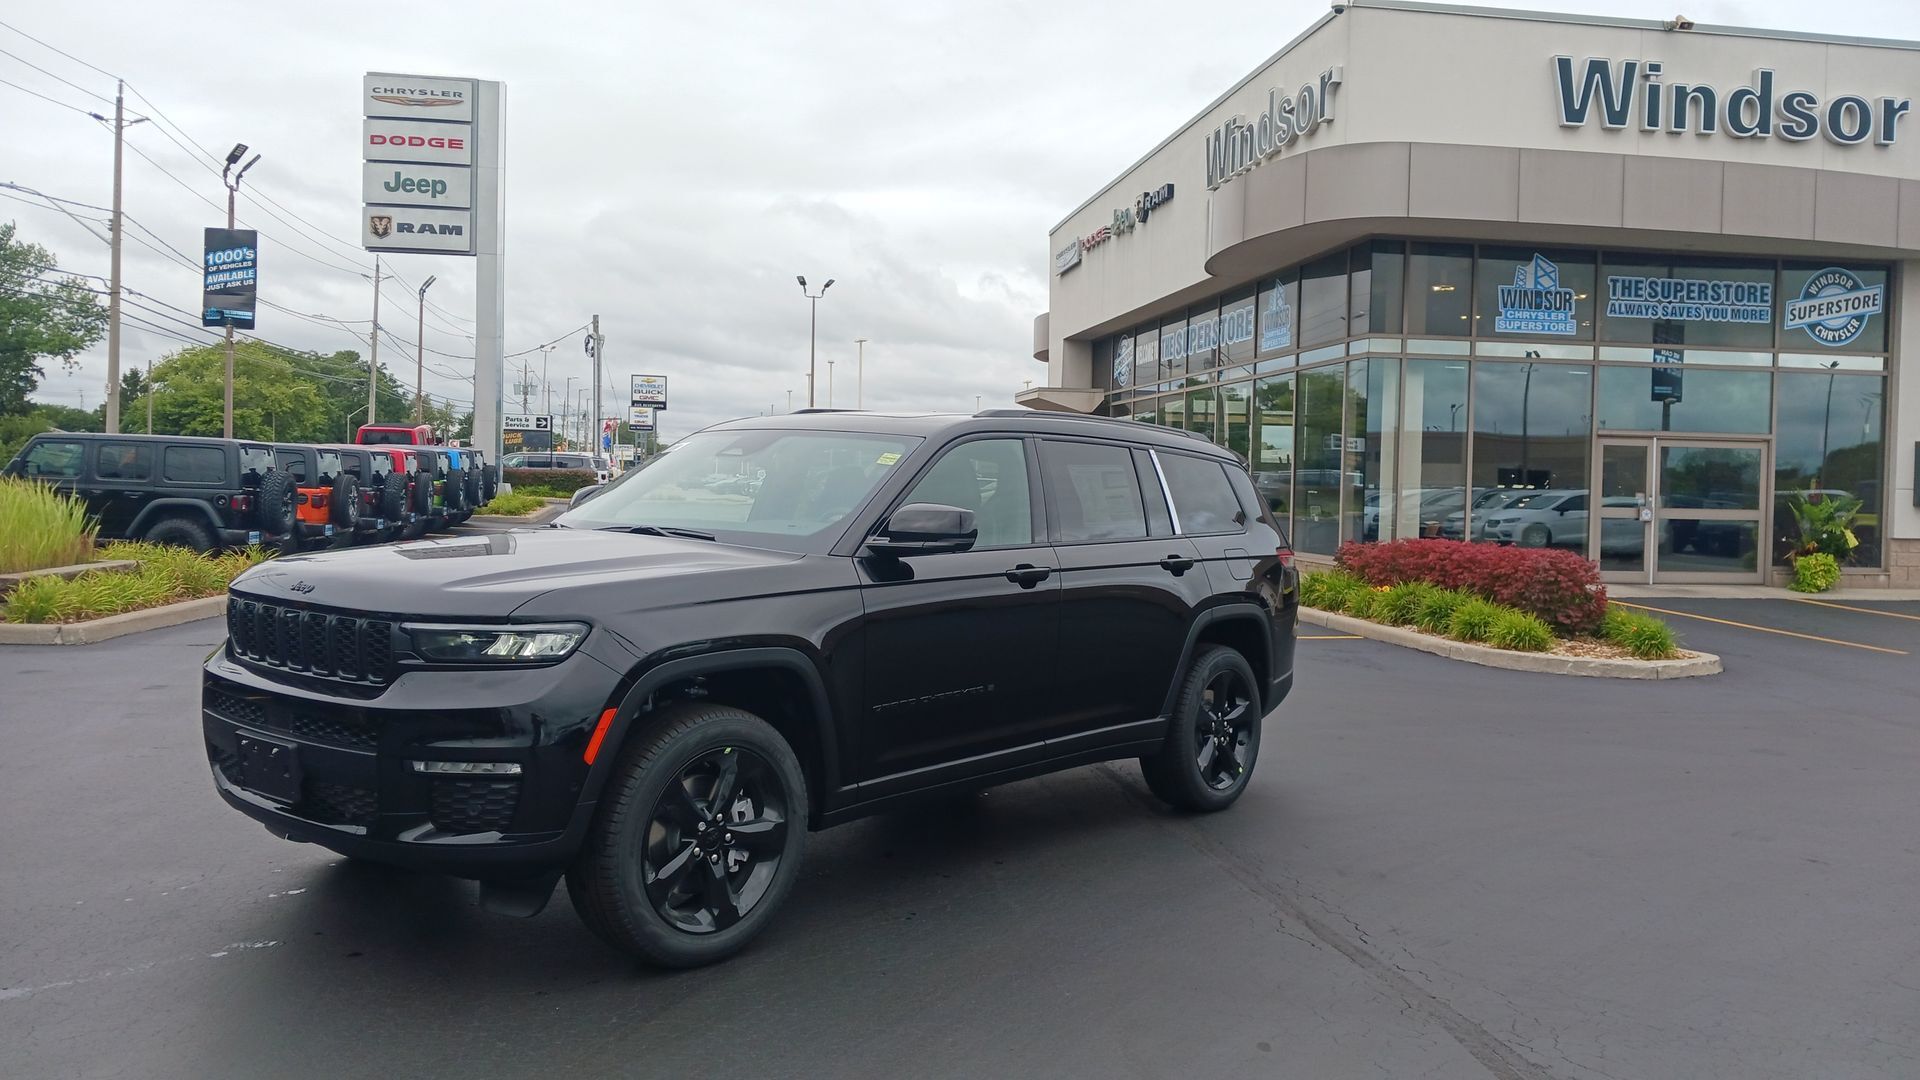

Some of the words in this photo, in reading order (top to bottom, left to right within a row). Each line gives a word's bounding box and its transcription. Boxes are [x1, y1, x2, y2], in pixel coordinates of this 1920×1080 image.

[372, 86, 463, 98] CHRYSLER
[1552, 53, 1912, 147] Windsor
[1205, 64, 1344, 191] Windsor
[369, 134, 464, 150] DODGE
[384, 171, 447, 198] Jeep
[1144, 184, 1174, 211] RAM
[396, 222, 463, 236] RAM
[207, 248, 255, 265] 1000's
[219, 260, 252, 270] VEHICLES
[207, 269, 255, 283] AVAILABLE
[1809, 273, 1854, 295] WINDSOR
[206, 282, 225, 291] JUST
[226, 280, 242, 288] ASK
[1609, 277, 1644, 298] THE
[1648, 279, 1770, 304] SUPERSTORE
[1500, 288, 1573, 312] WINDSOR
[1789, 293, 1879, 321] SUPERSTORE
[1507, 311, 1566, 321] CHRYSLER
[1609, 303, 1658, 316] ALWAYS
[1662, 305, 1701, 318] SAVES
[1704, 307, 1728, 319] YOU
[1731, 308, 1769, 321] MORE!
[1499, 320, 1574, 332] SUPERSTORE
[1815, 318, 1860, 341] CHRYSLER
[290, 580, 316, 595] Jeep
